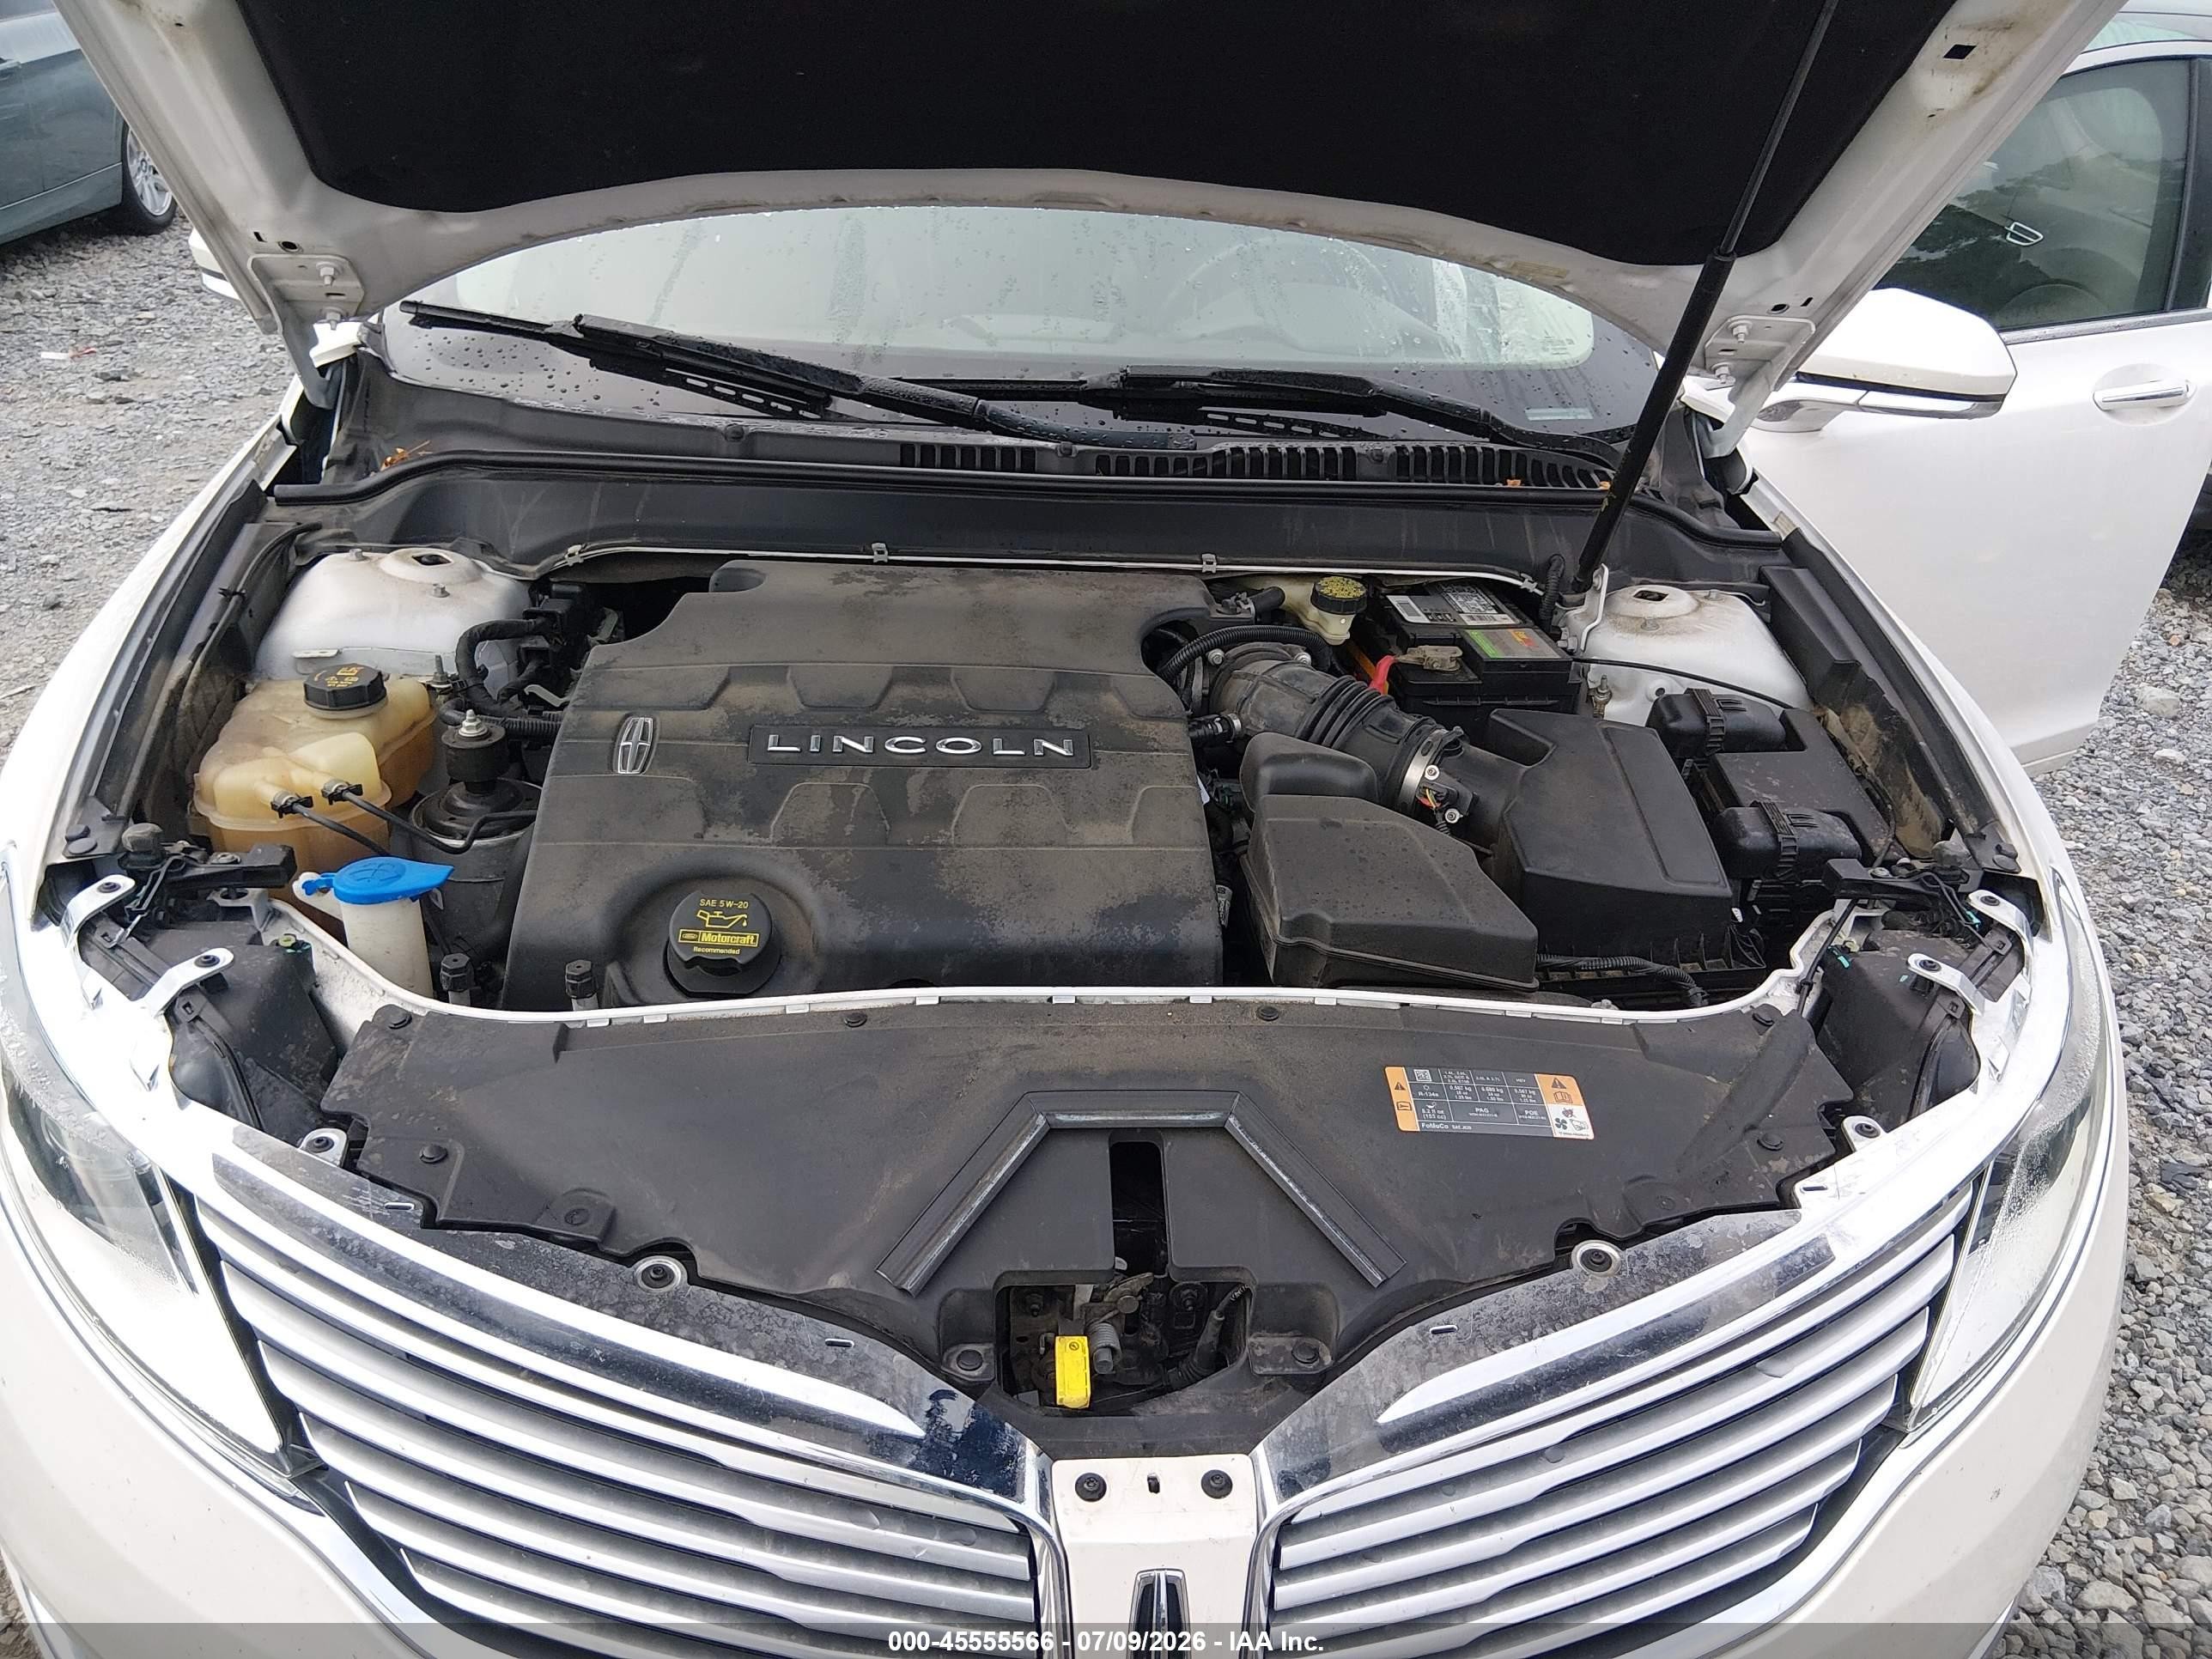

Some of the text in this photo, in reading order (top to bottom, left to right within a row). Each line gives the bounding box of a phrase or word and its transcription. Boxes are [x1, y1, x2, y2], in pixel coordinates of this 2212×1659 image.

[767, 734, 1075, 757] LINCOLN
[699, 898, 749, 909] SAE 5W-20
[702, 933, 756, 945] Motorcraft
[694, 946, 740, 955] Recommended
